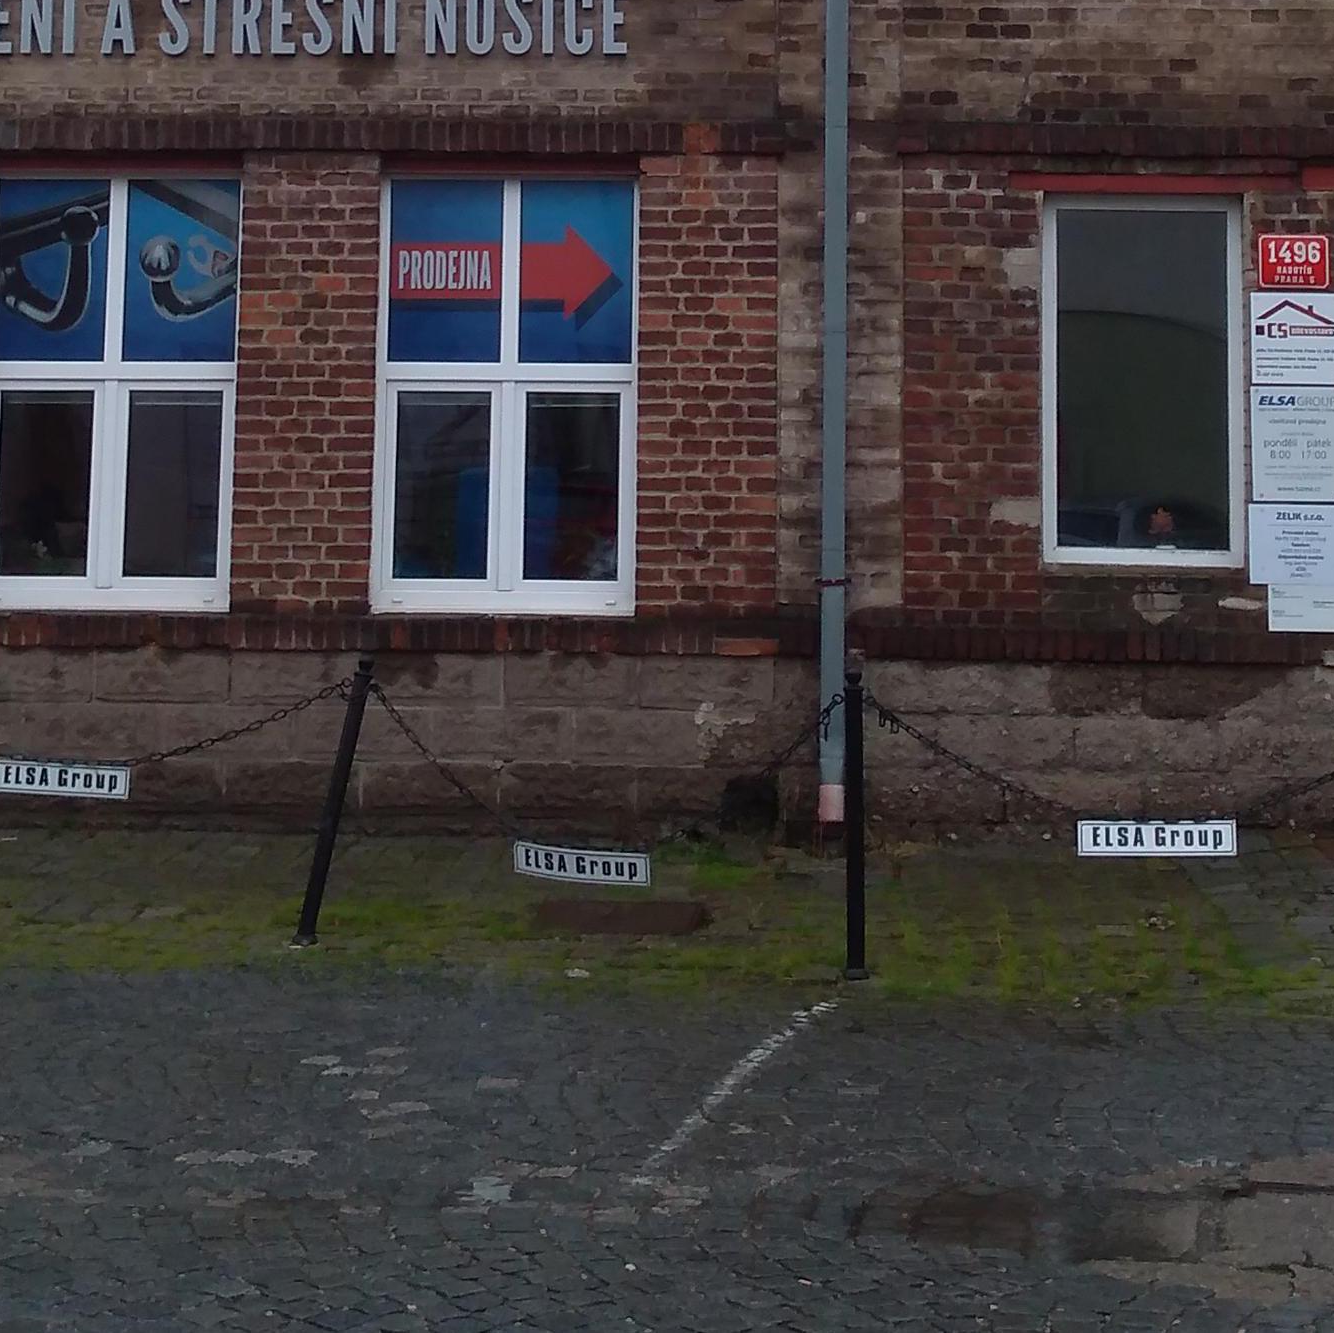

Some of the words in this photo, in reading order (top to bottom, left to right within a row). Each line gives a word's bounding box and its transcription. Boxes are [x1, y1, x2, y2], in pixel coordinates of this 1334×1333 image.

[1268, 240, 1321, 263] 1496
[397, 250, 492, 290] PRODEJNA
[3, 766, 49, 786] ELSA
[58, 769, 118, 792] Group
[1092, 826, 1145, 847] ELSA
[1154, 827, 1223, 850] Group
[524, 848, 568, 873] ELSA
[575, 856, 638, 880] Group
